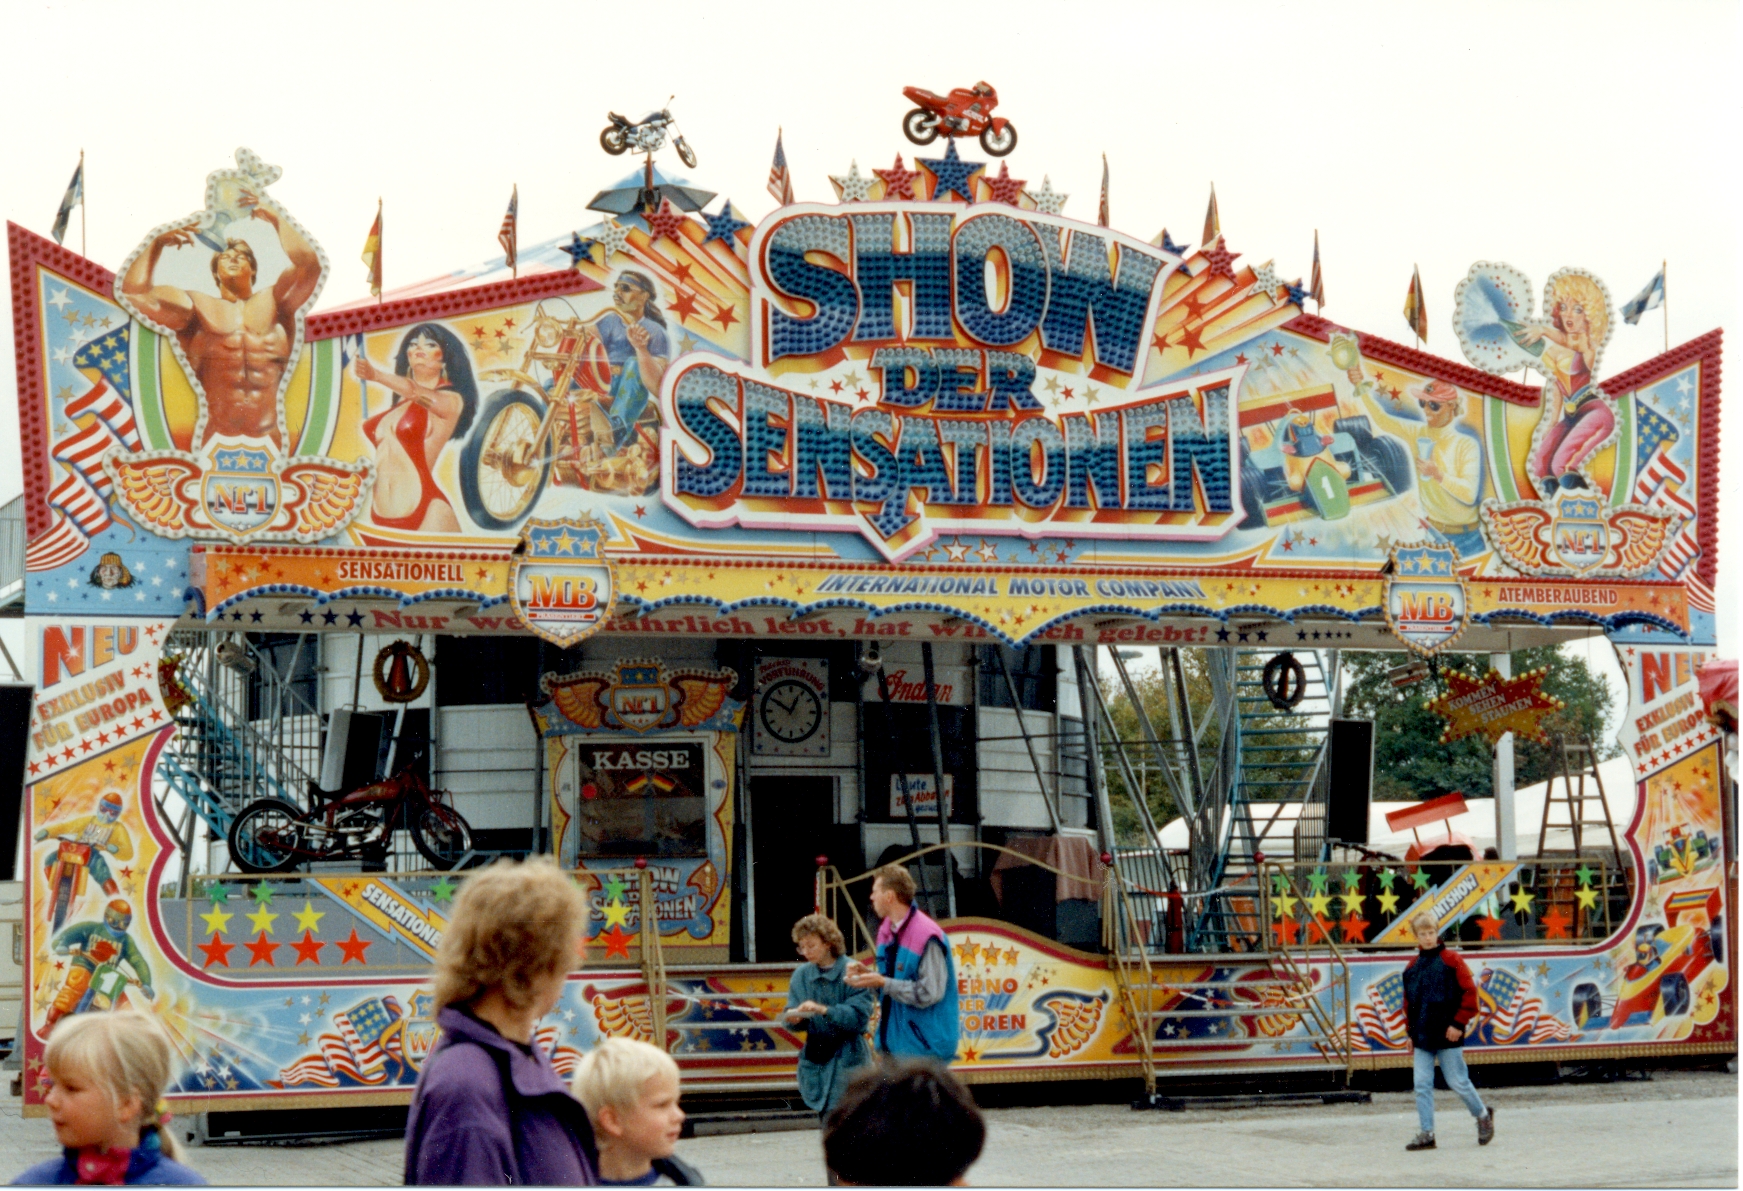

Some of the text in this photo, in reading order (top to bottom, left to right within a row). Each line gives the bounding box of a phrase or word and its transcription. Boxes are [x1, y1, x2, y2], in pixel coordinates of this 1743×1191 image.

[765, 211, 1166, 374] SHOW
[869, 347, 1046, 414] DER
[671, 362, 1234, 538] SENSATIONEN
[338, 558, 465, 584] SENSATIONELL
[814, 573, 1208, 600] INTERNATIONAL MOTOR COMPANY
[526, 574, 599, 612] MB
[1398, 590, 1456, 624] MB
[1498, 586, 1618, 605] ATEMBERAUBEND
[370, 609, 450, 631] Nur
[467, 616, 525, 631] we
[604, 613, 756, 635] fährlich
[853, 618, 911, 637] hat
[1098, 621, 1208, 643] gelebt!
[42, 625, 139, 689] NEU
[37, 669, 126, 723] EXKLUSIV
[1447, 684, 1497, 711] KOMMEN
[1468, 693, 1507, 716] SEHEN
[1480, 696, 1533, 724] STAUNEN
[1635, 690, 1695, 734] EXKLUSIV
[32, 687, 154, 752] FÜR EUROPA
[1633, 709, 1705, 758] FÜR EUROP
[592, 750, 690, 770] KASSE
[895, 777, 927, 791] Lute
[361, 883, 443, 949] SENSATIONE
[957, 977, 1019, 995] ERNO
